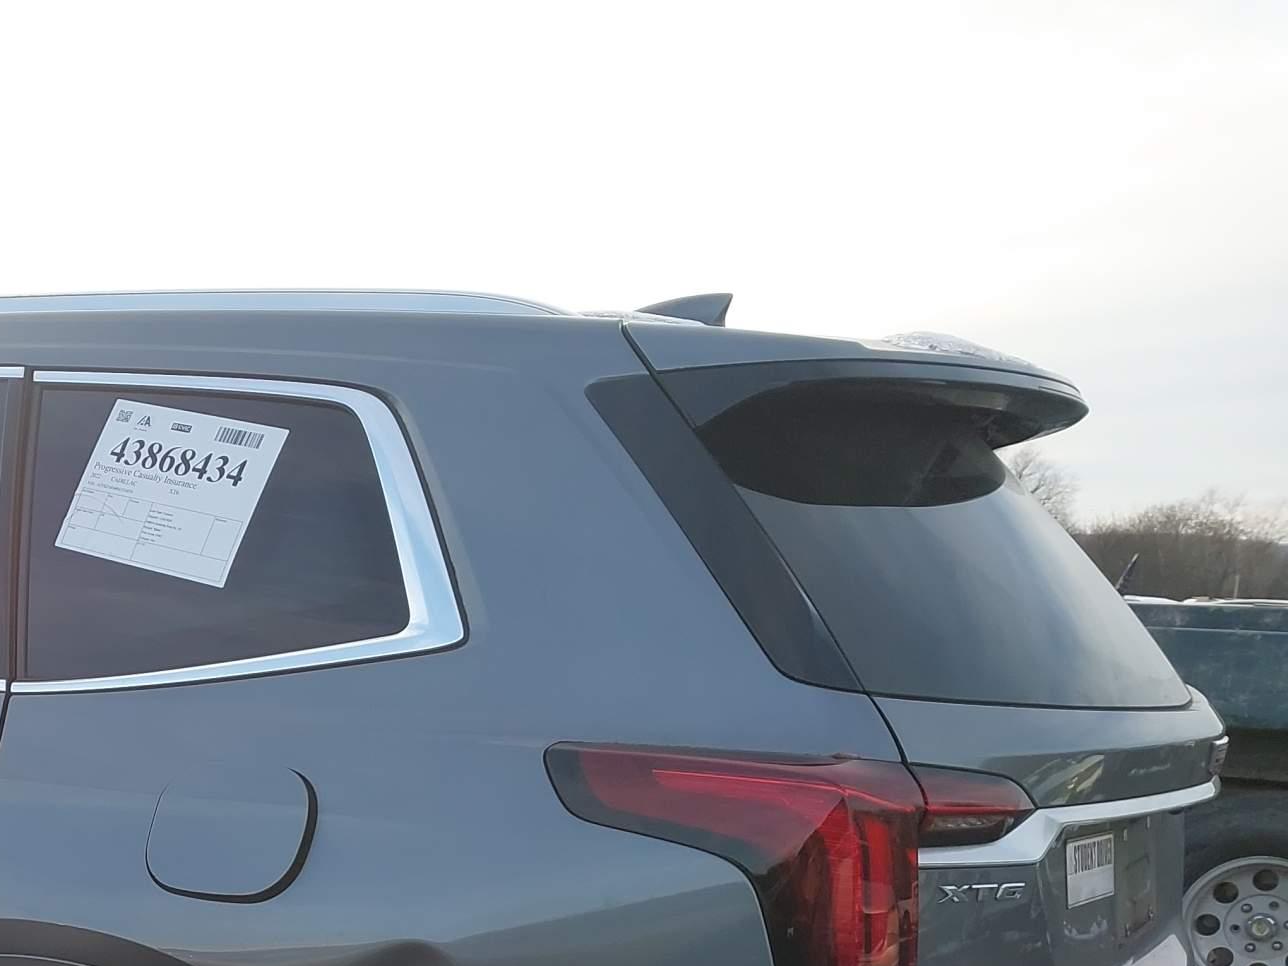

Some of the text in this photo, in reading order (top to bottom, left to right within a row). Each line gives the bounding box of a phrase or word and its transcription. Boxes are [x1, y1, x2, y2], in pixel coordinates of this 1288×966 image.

[94, 462, 198, 490] Progressive Casualty Insurance
[110, 436, 248, 487] 43868434
[1073, 841, 1097, 875] STUDENT
